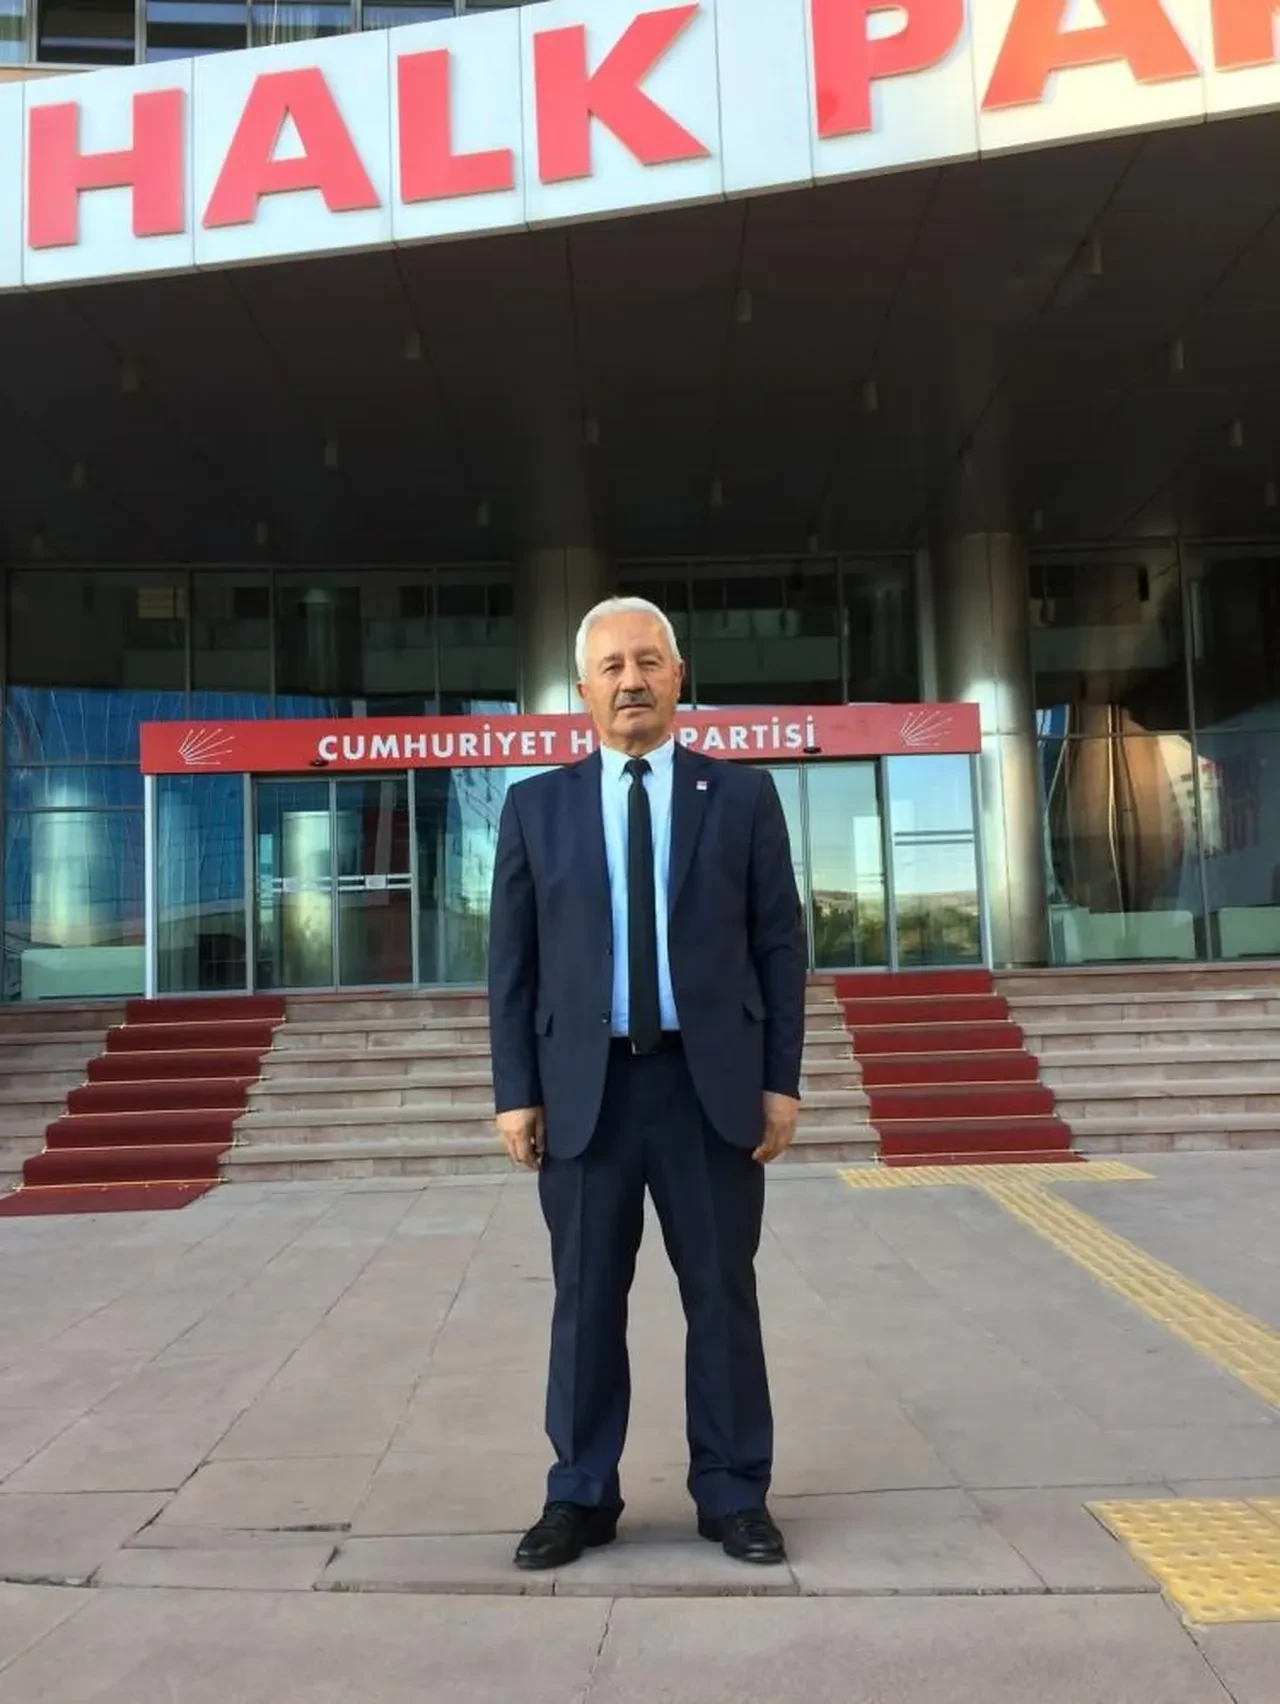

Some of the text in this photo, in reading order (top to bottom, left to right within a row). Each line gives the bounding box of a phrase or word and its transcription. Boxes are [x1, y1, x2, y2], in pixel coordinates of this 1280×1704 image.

[28, 3, 712, 249] HALK
[318, 723, 557, 761] CUMHURİYET
[679, 714, 816, 750] PARTİSİ
